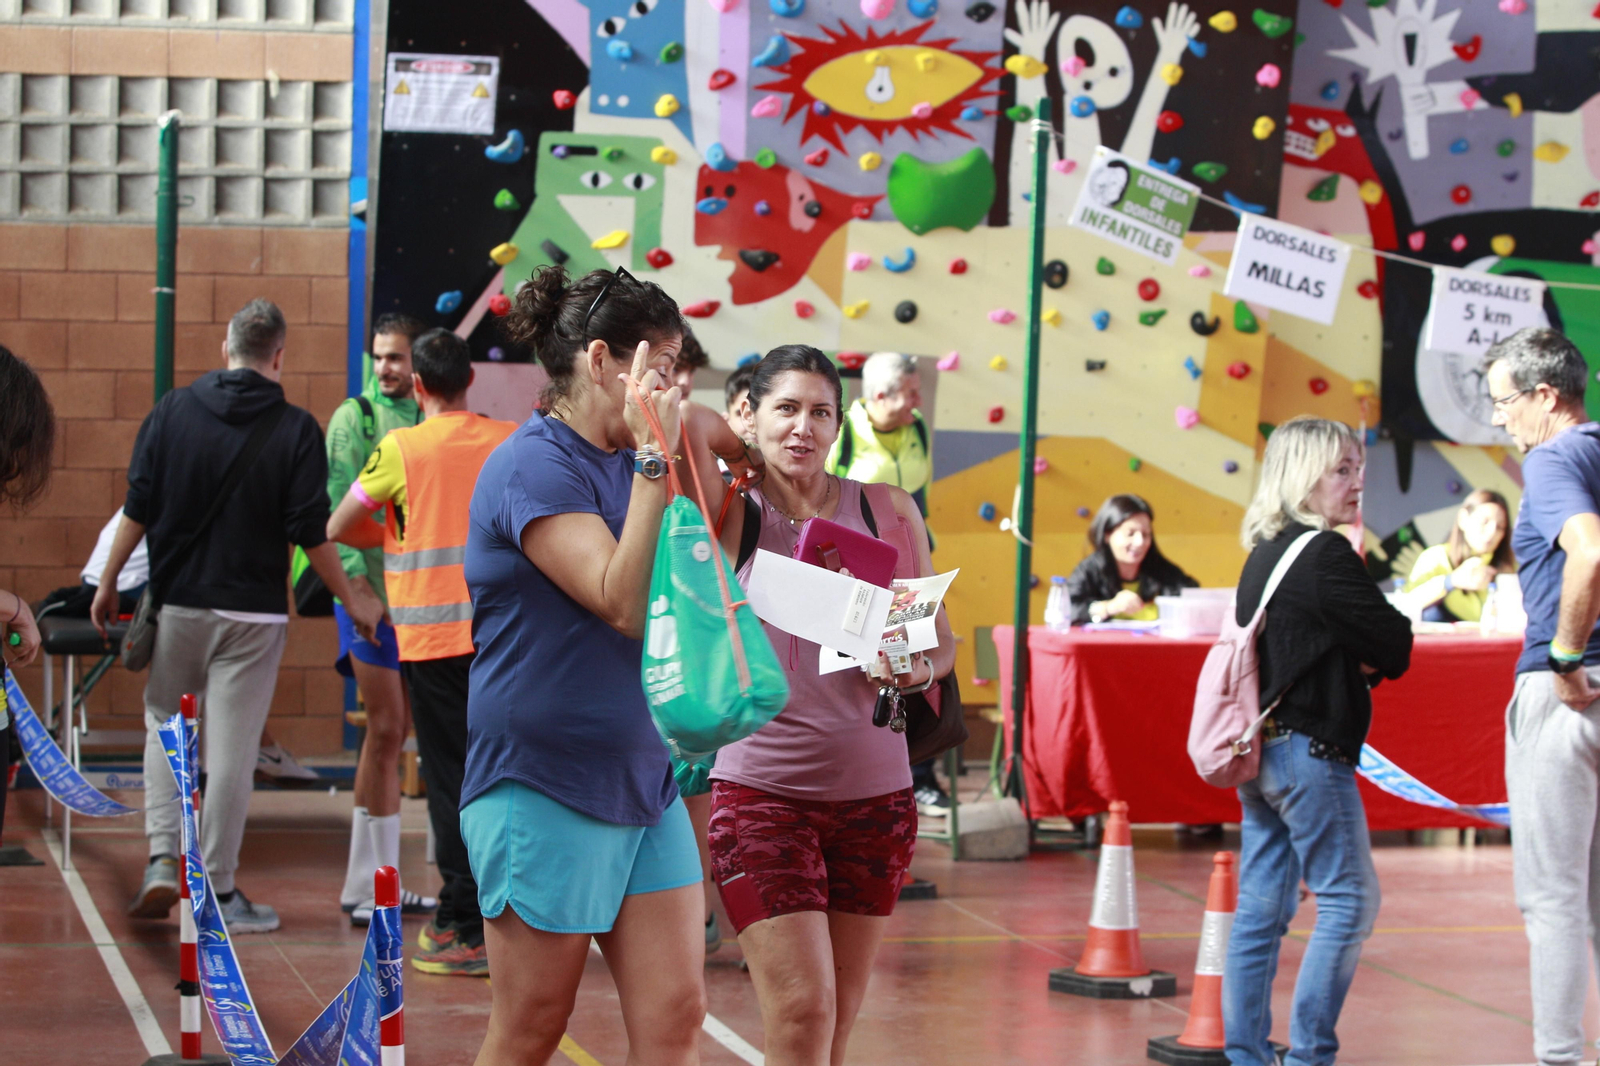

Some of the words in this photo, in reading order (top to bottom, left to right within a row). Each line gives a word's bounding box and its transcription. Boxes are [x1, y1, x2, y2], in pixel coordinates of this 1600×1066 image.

[1137, 174, 1188, 205] ENTREGA
[1149, 195, 1167, 212] DE
[1081, 207, 1173, 258] INFANTILES
[1122, 200, 1182, 235] DORSALES
[1253, 225, 1337, 263] DORSALES
[1247, 260, 1325, 298] MILLAS
[1449, 278, 1531, 302] DORSALES
[1463, 303, 1475, 320] 5
[1484, 307, 1512, 325] km
